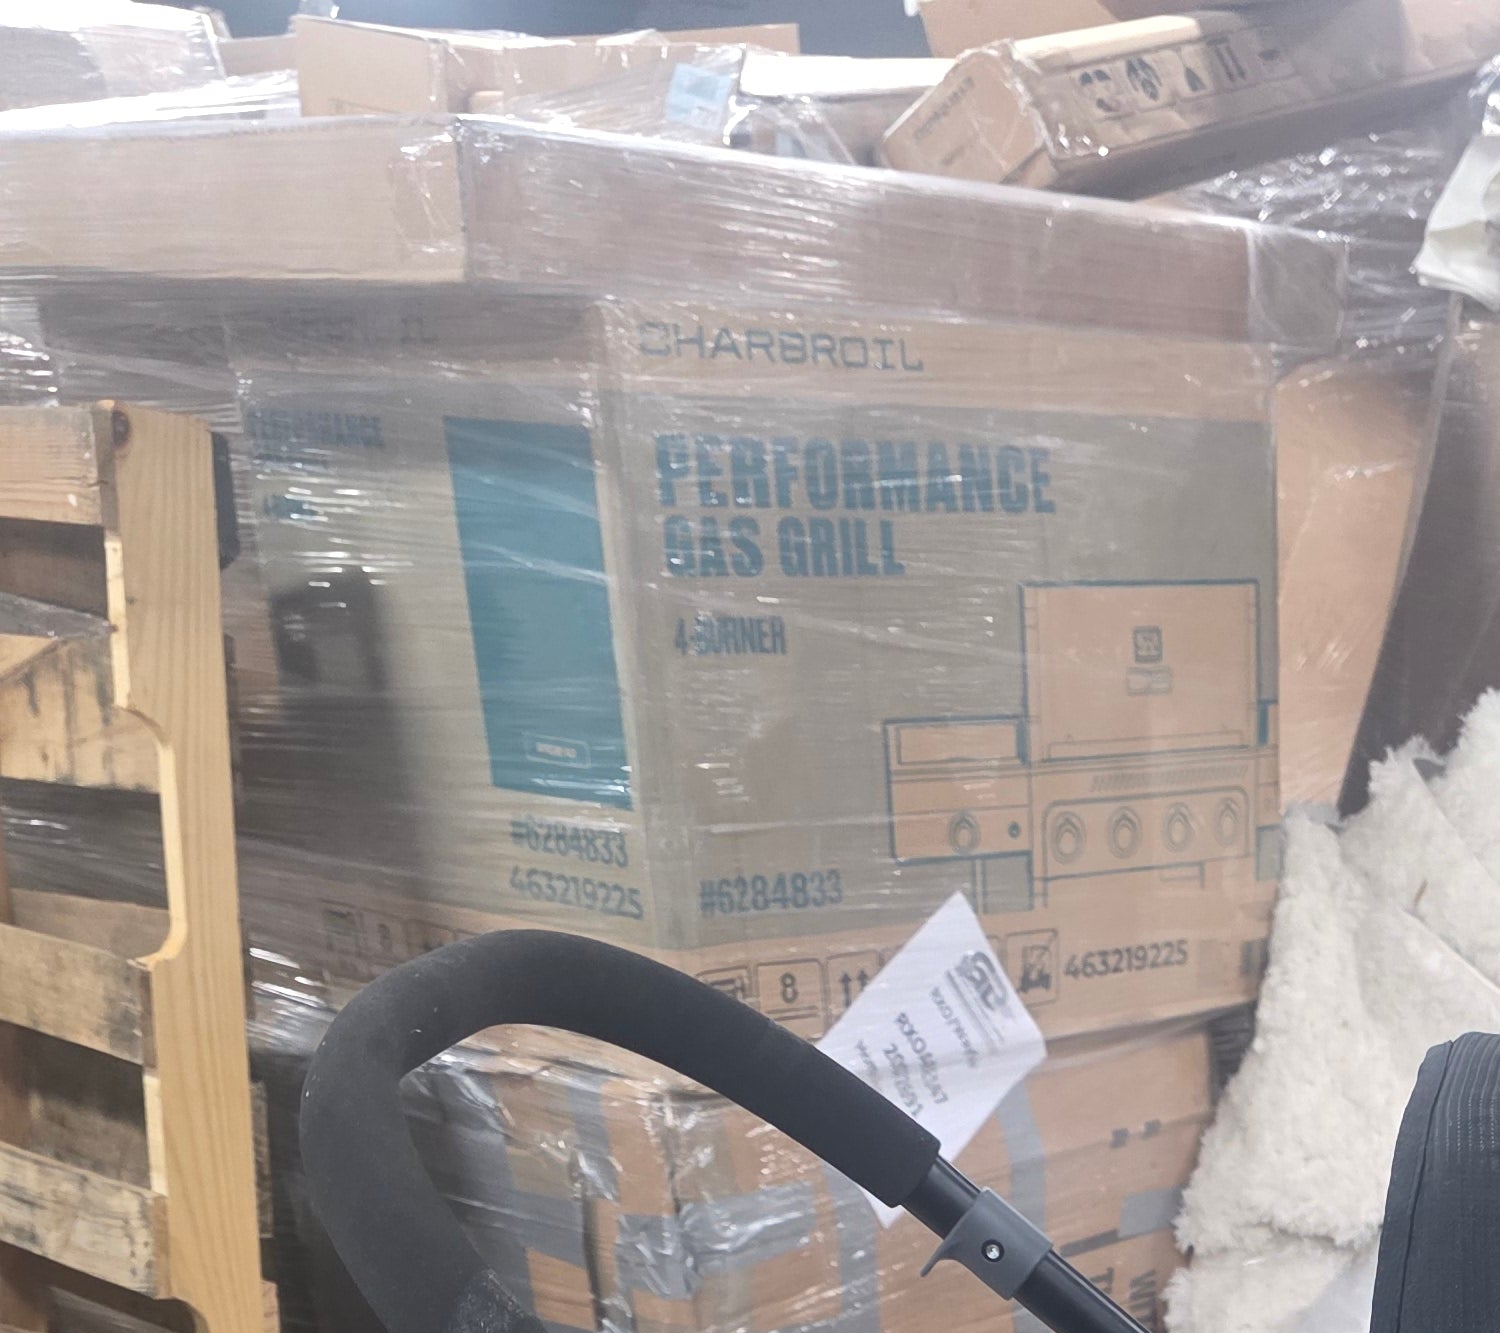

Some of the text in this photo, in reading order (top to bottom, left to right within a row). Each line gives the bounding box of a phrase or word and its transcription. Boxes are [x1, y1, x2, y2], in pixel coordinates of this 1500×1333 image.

[638, 321, 924, 372] CHARBROIL
[655, 433, 1057, 514] PERFORMANCE
[662, 514, 906, 578] GAS GRILL
[509, 865, 645, 920] 463219225
[700, 868, 843, 915] #6284833
[1064, 939, 1189, 979] 463219225
